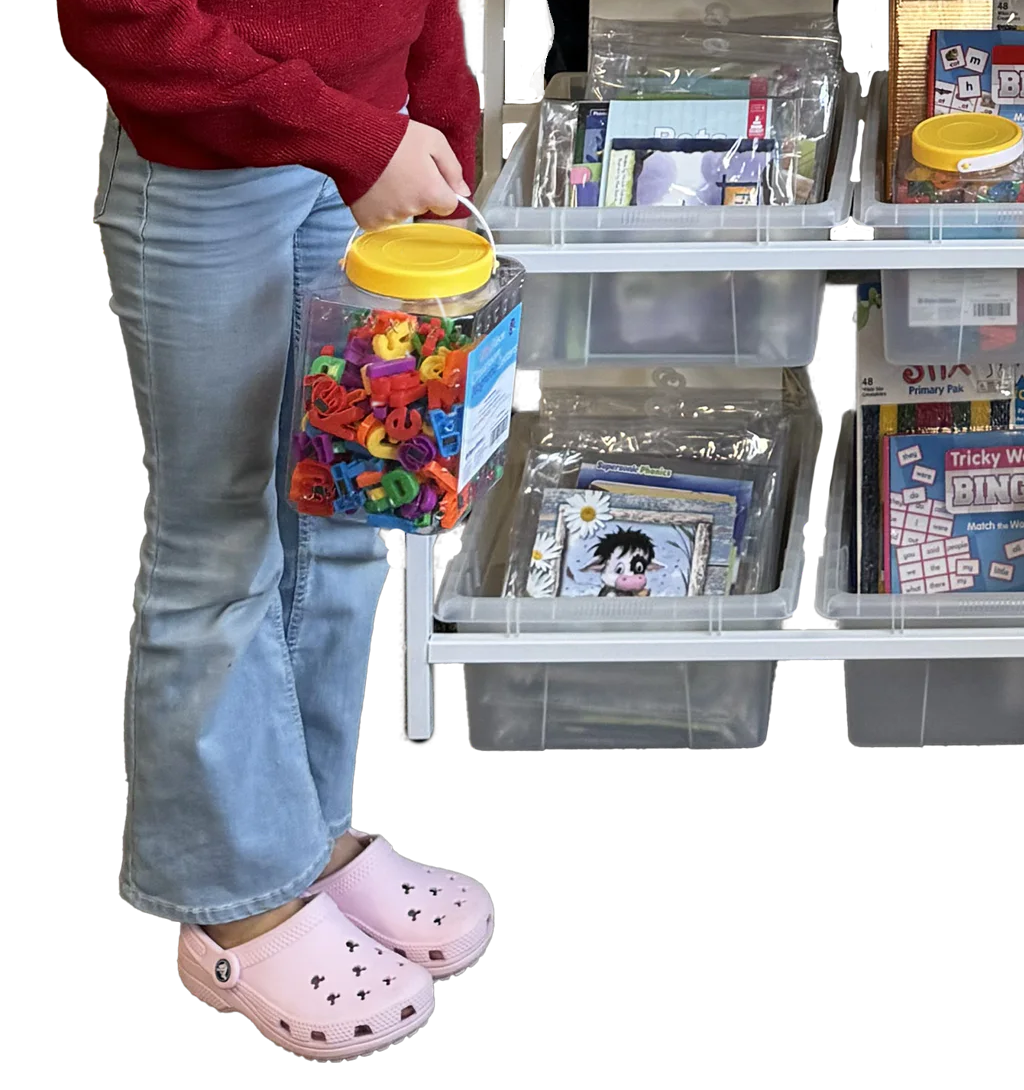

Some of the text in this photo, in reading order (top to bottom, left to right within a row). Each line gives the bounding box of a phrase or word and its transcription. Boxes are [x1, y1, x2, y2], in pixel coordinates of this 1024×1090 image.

[997, 2, 1008, 10] 48
[969, 56, 981, 66] m
[965, 81, 973, 91] h
[862, 377, 873, 386] 48
[909, 384, 964, 396] Primary Pak
[949, 449, 1000, 467] Tricky
[967, 520, 995, 530] Match
